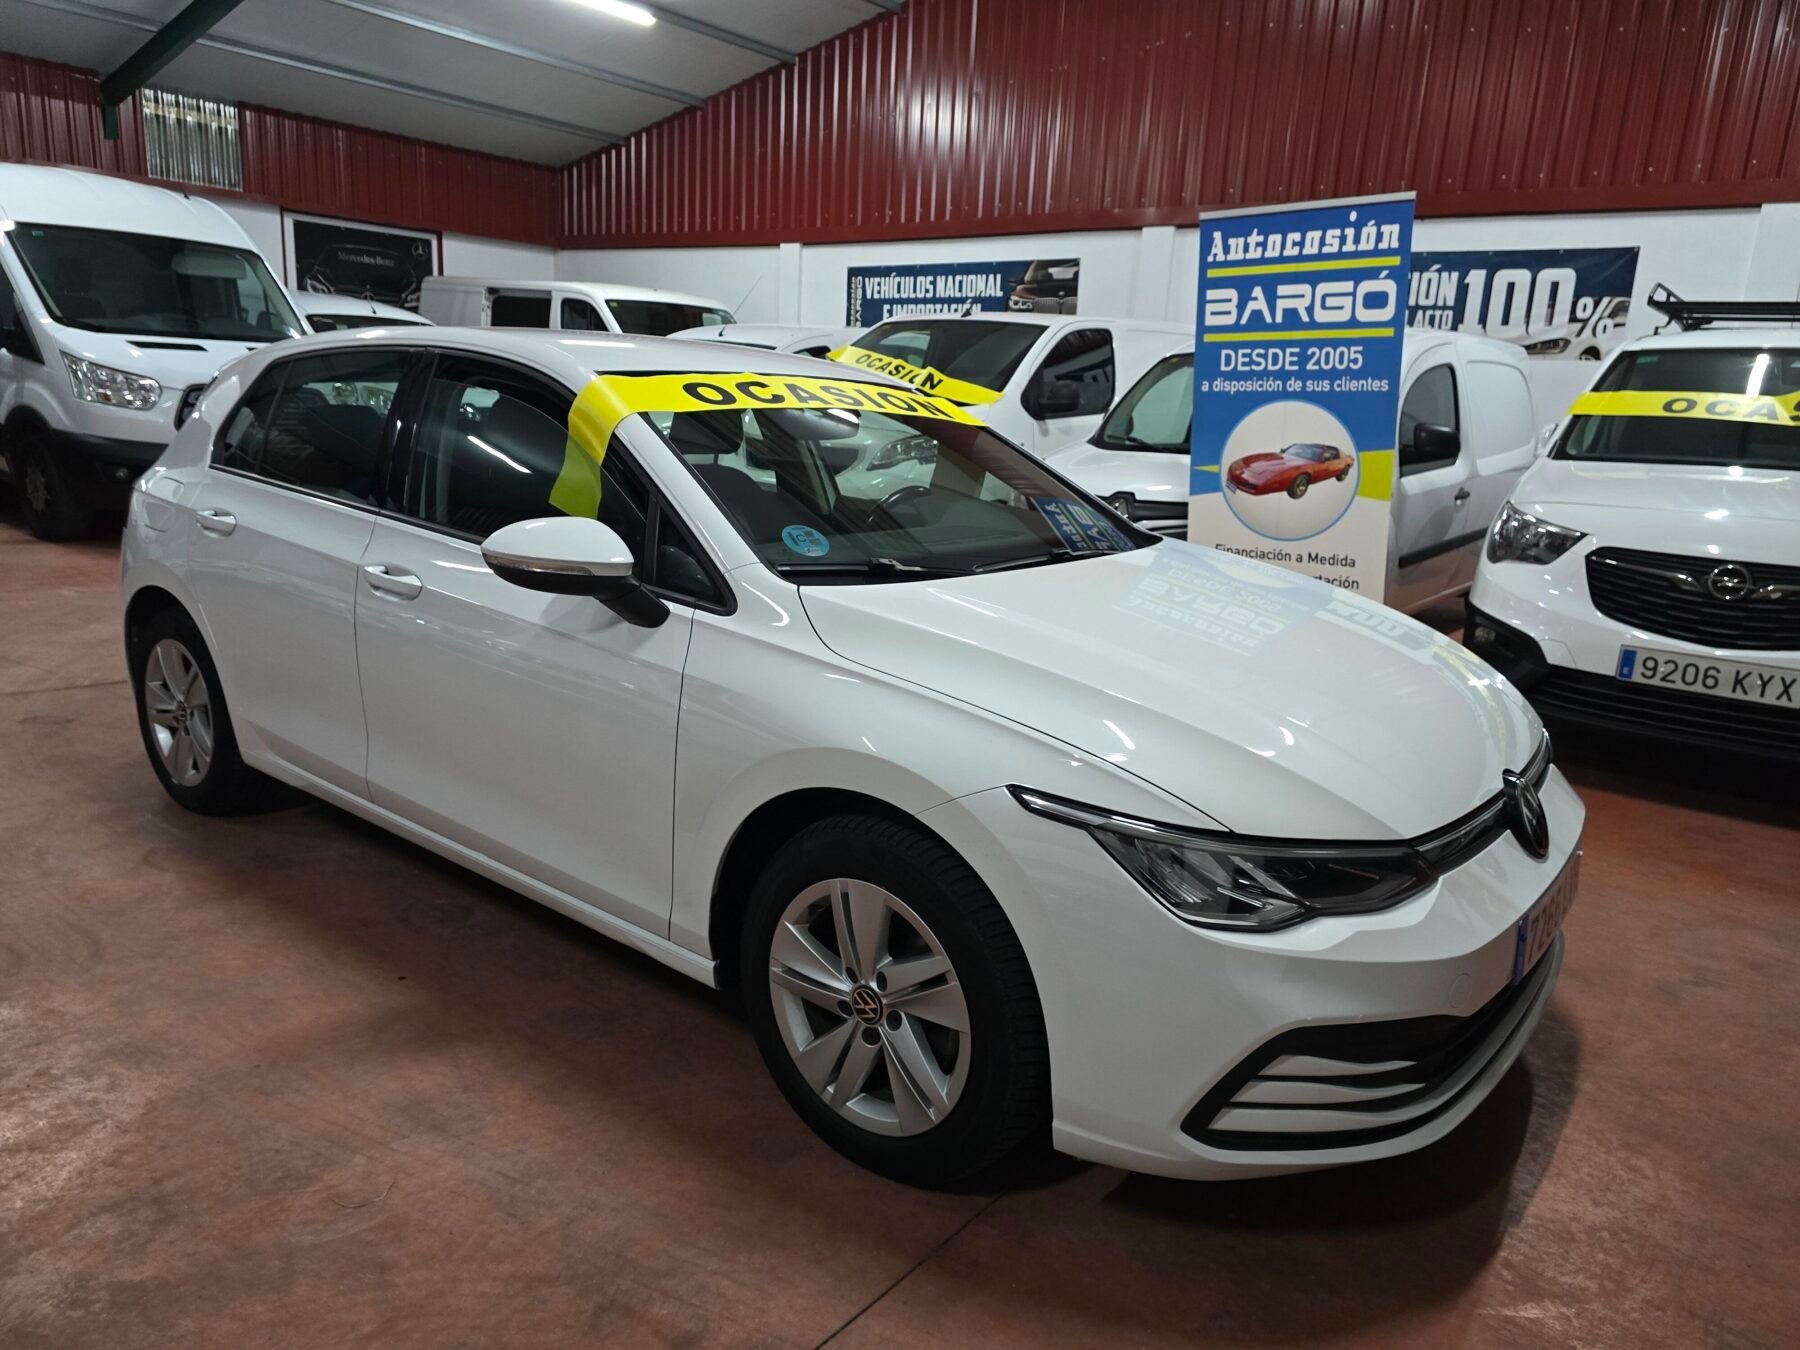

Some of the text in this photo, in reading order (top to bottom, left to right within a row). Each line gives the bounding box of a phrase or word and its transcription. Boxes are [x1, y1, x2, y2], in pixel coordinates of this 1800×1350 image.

[1207, 211, 1400, 262] Autocasión
[865, 272, 1003, 299] VEHÍCULOS NACIONAL
[1204, 270, 1396, 326] BARGÓ
[1408, 264, 1459, 306] IÓN
[1412, 309, 1454, 330] ACTO
[1220, 346, 1363, 371] DESDE 2005
[1201, 376, 1389, 394] a disposición de sus clientes
[1296, 554, 1303, 563] a
[1308, 552, 1356, 568] Medida
[1641, 656, 1797, 703] 9206 KYX
